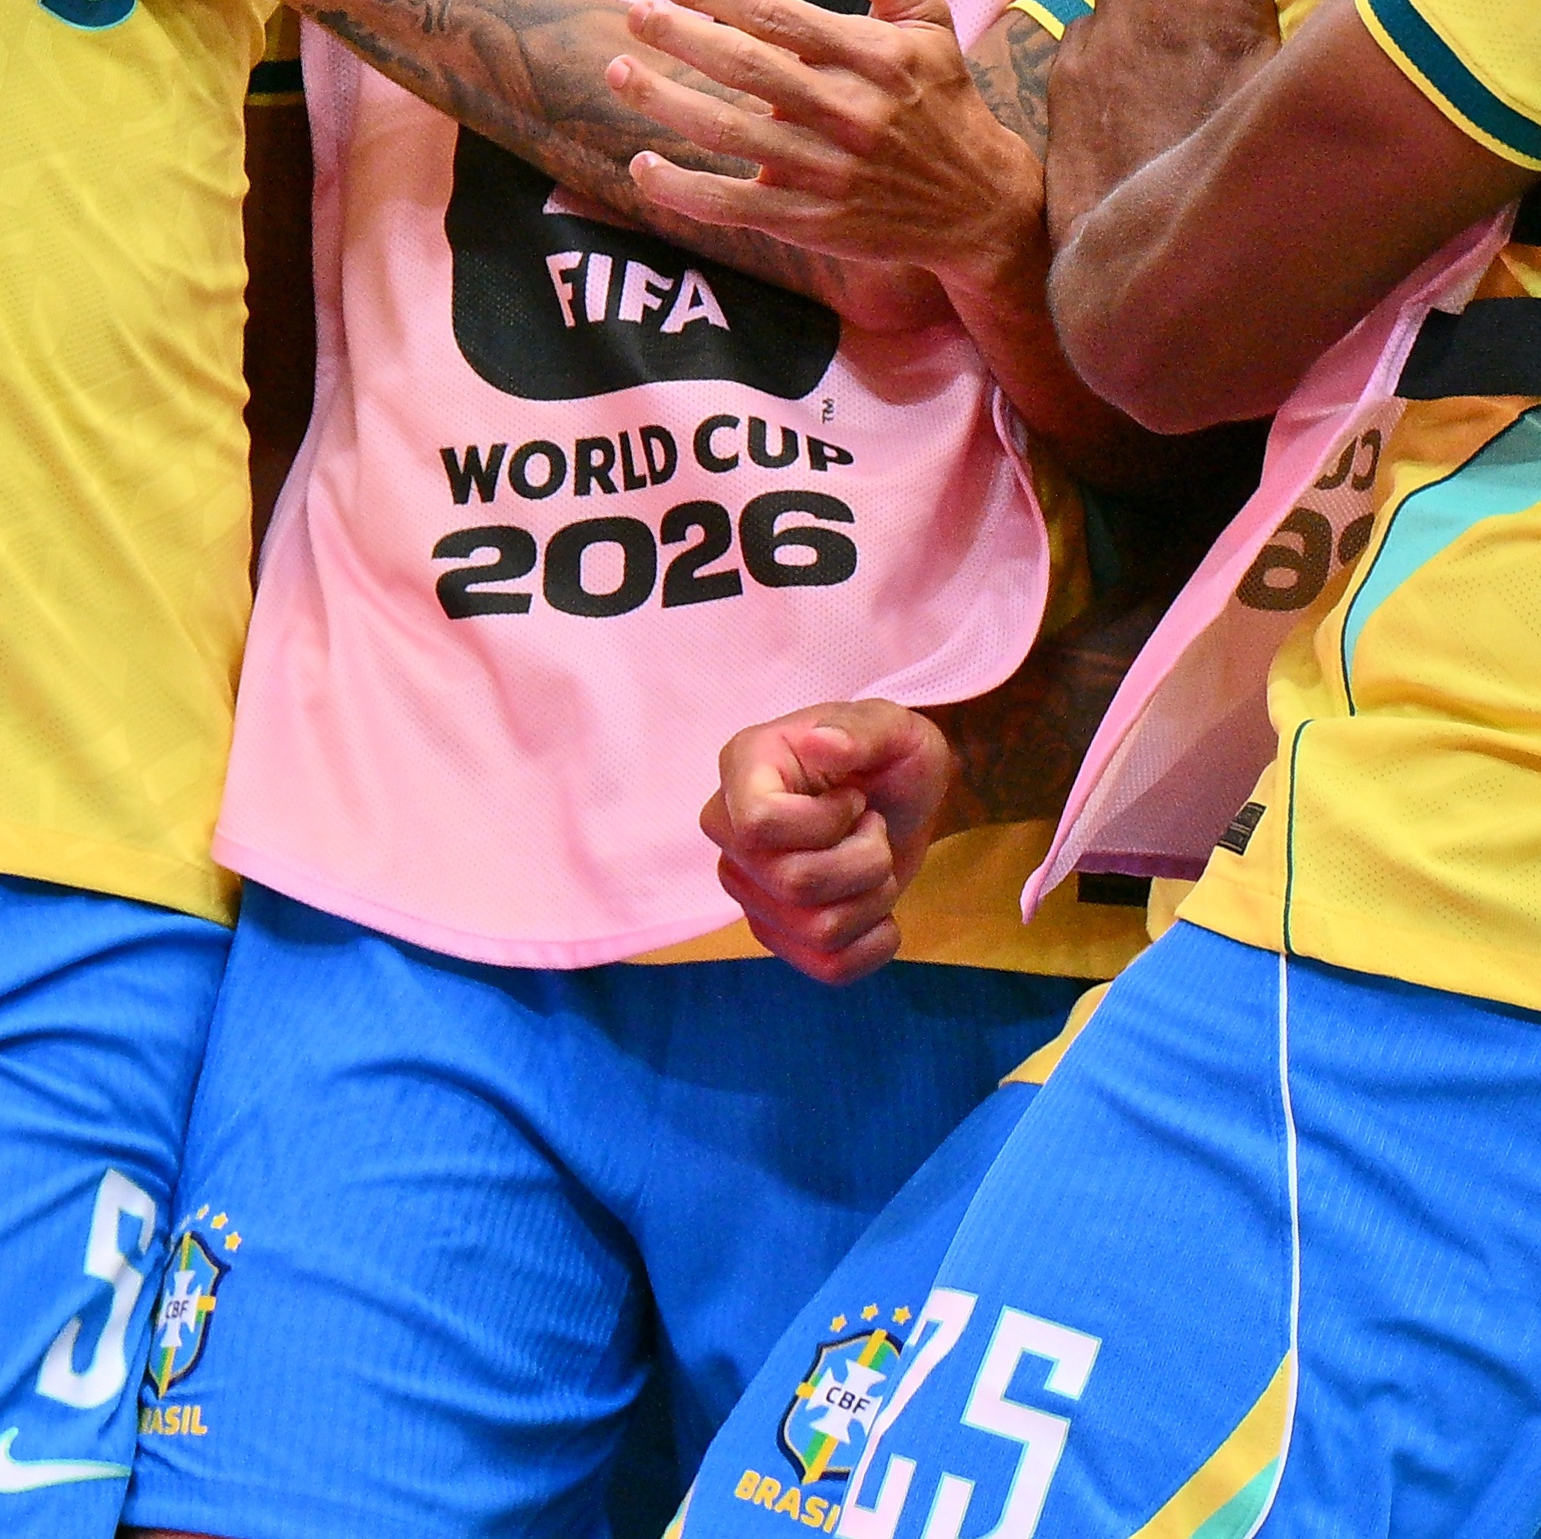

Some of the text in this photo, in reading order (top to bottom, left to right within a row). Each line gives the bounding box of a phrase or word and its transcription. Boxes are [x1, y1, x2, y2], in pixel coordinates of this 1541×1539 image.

[546, 251, 730, 334] FIFA
[440, 414, 854, 505] WORLD CUP
[432, 489, 858, 620] 2026
[35, 1167, 156, 1409] 5
[165, 1300, 189, 1319] CBF
[141, 1405, 208, 1435] ASIL
[826, 1385, 871, 1416] CBF
[833, 1286, 1103, 1539] 25
[734, 1469, 841, 1533] BRASI
